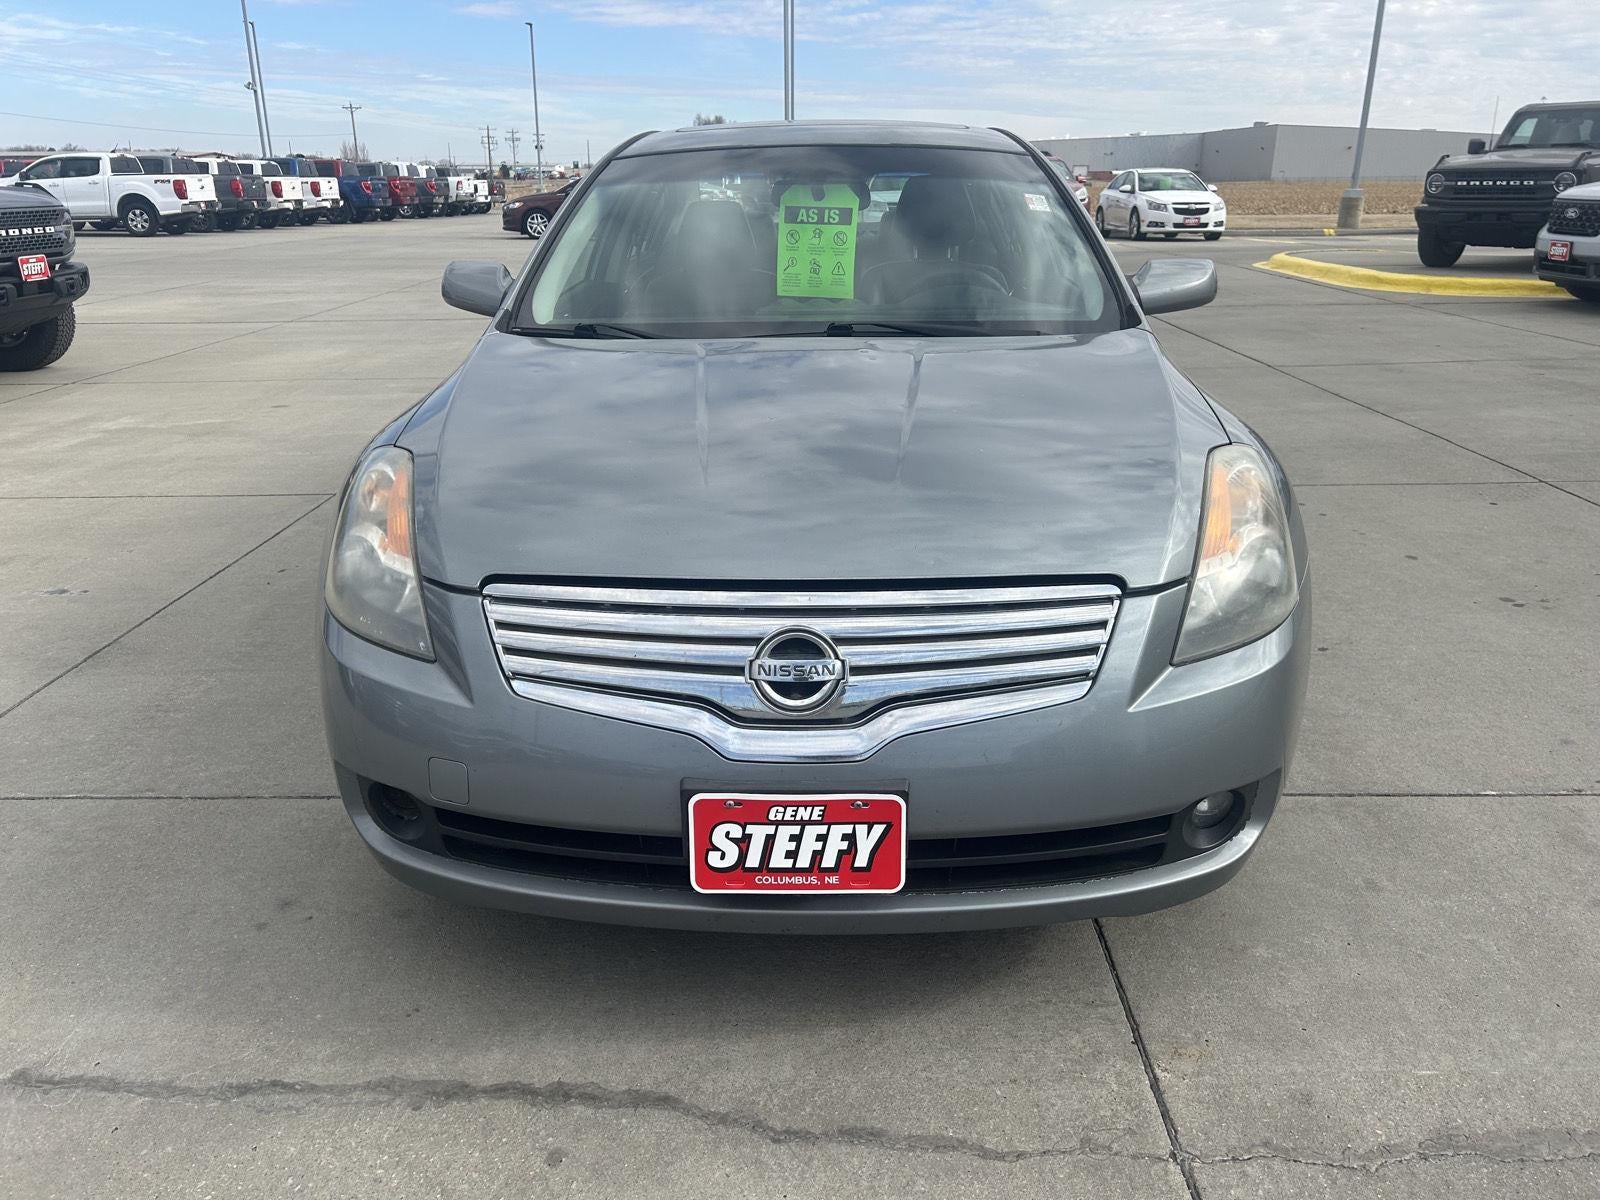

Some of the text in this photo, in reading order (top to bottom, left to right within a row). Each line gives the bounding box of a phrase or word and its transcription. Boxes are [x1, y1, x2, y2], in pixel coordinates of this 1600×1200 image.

[797, 208, 840, 224] AS IS
[22, 261, 45, 276] STEFFY
[757, 663, 836, 677] NISSAN
[767, 805, 825, 821] GENE
[706, 822, 888, 870] STEFFY
[754, 875, 840, 885] COLUMBUS, NE
